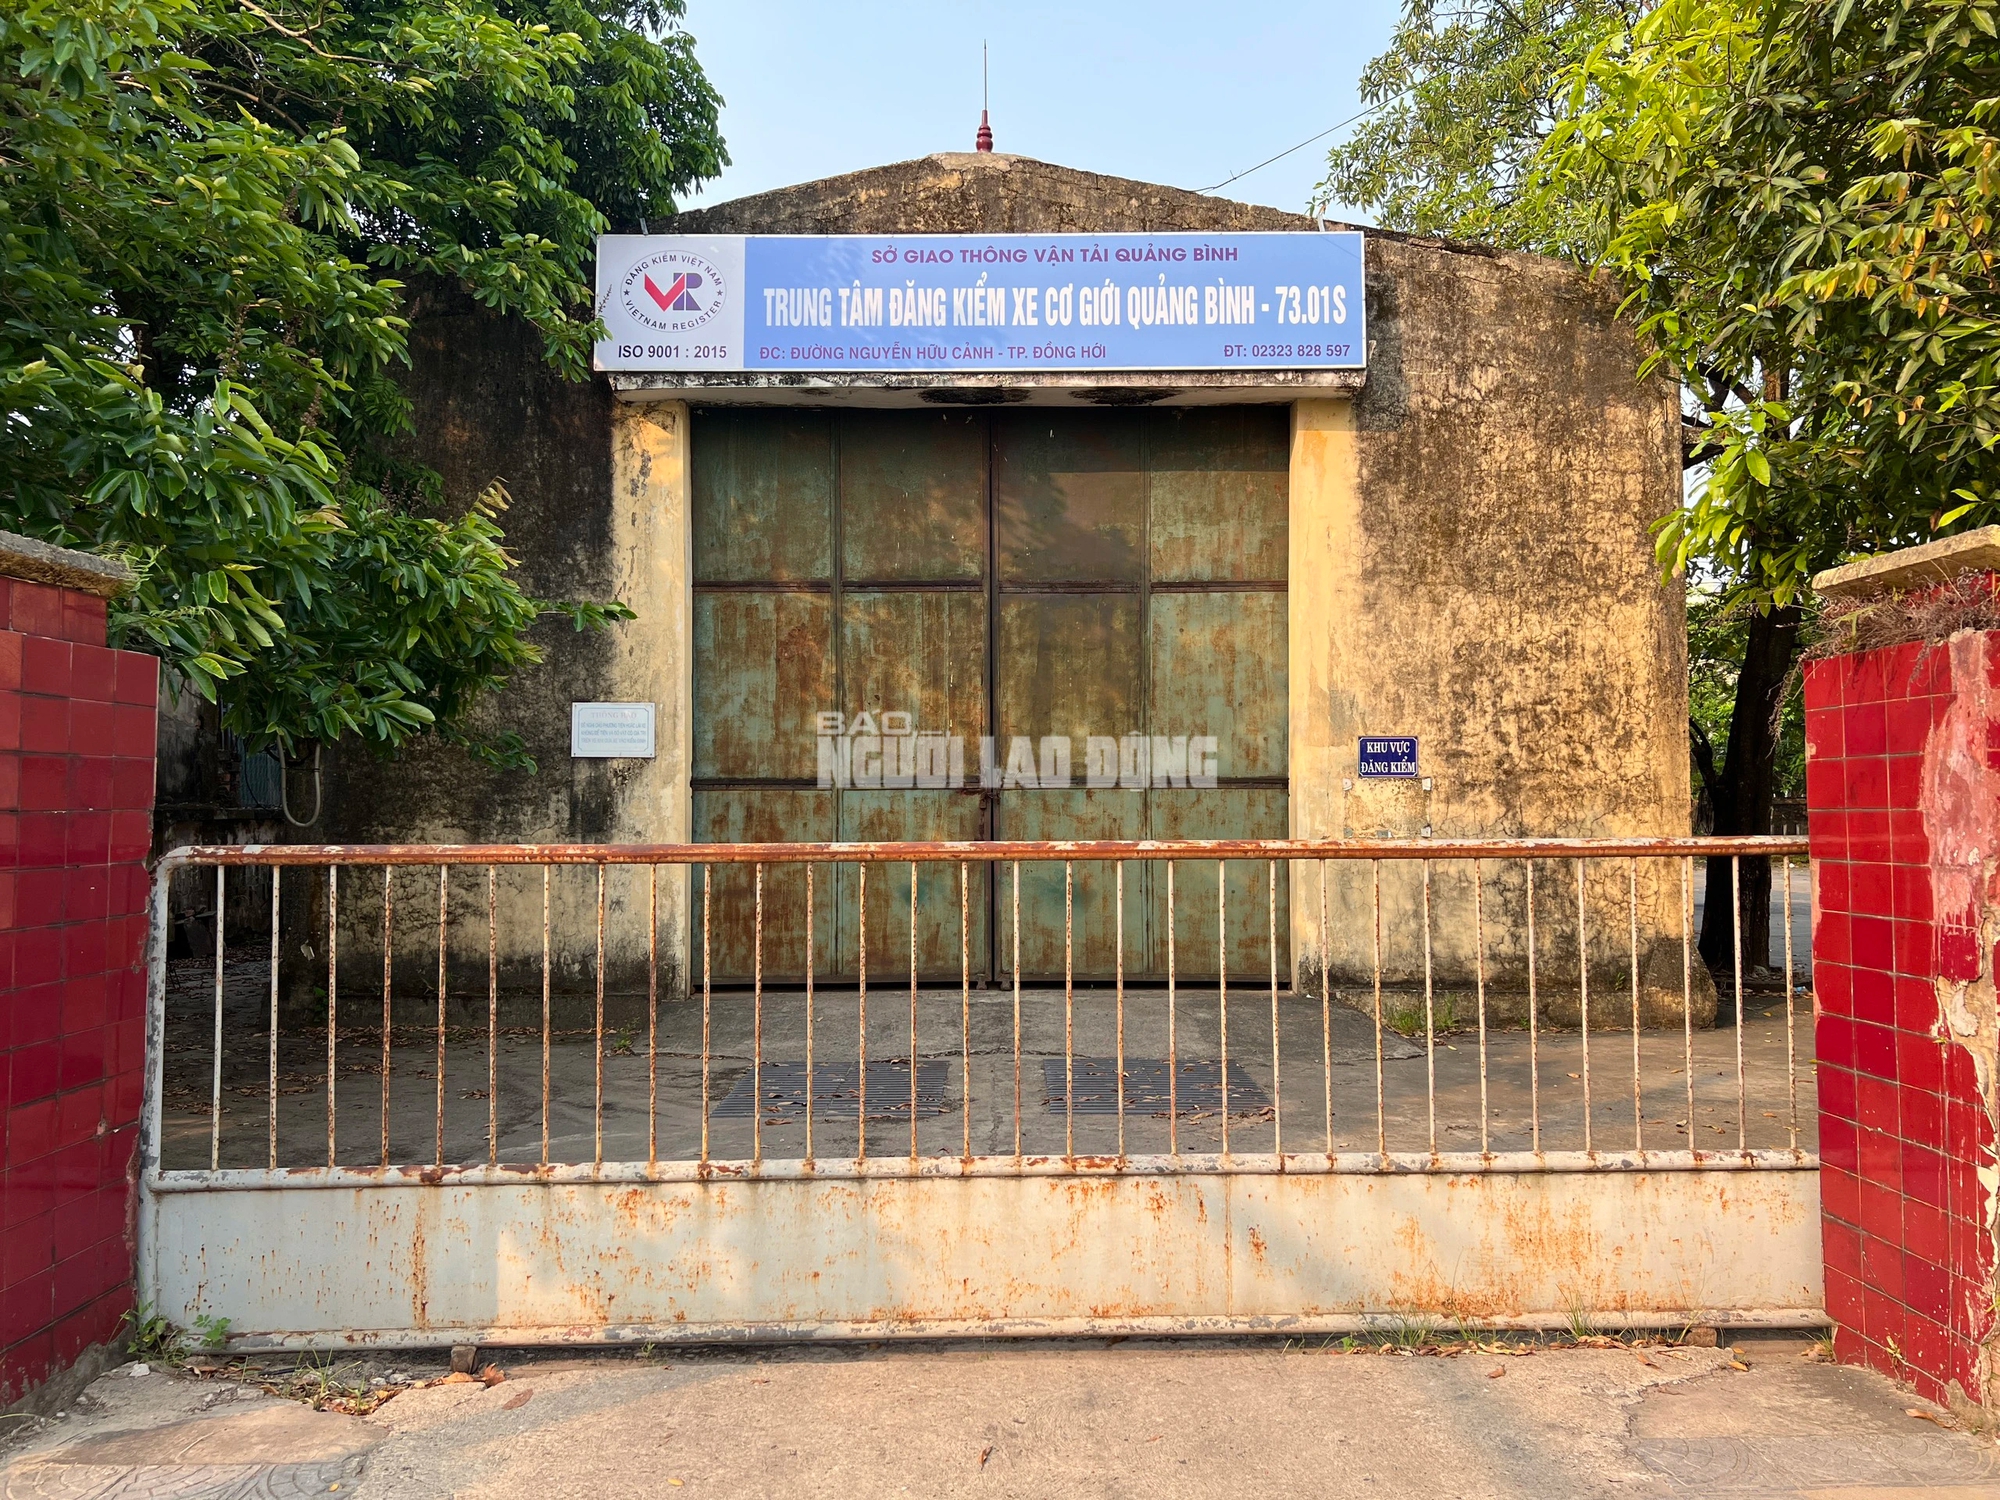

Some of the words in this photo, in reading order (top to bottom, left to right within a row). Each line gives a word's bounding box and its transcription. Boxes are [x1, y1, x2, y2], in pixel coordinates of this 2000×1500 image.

[871, 245, 898, 264] SỞ
[904, 249, 954, 264] GIAO
[960, 245, 1028, 263] THÔNG
[1034, 245, 1074, 266] VẬN
[1080, 243, 1109, 262] TẢI
[1115, 243, 1187, 262] QUẢNG
[1193, 243, 1238, 262] BÌNH
[704, 265, 723, 286] NAM
[763, 287, 832, 327] TRUNG
[838, 279, 883, 327] TÂM
[888, 279, 947, 327] ĐĂNG
[953, 271, 1006, 327] KIỂM
[1012, 287, 1039, 327] XE
[1045, 283, 1073, 326] CƠ
[1079, 278, 1121, 326] GIỚI
[1127, 272, 1198, 330] QUẢNG
[1204, 277, 1255, 325] BÌNH
[1261, 303, 1270, 312] -
[1275, 284, 1347, 325] 73.01S
[625, 299, 667, 330] VIETNAM
[672, 299, 722, 331] REGISTER
[618, 345, 644, 358] ISO
[647, 345, 680, 358] 9001
[694, 345, 727, 358] 2015
[759, 346, 786, 360] ĐC:
[790, 343, 844, 360] ĐƯỜNG
[849, 341, 912, 360] NGUYỄN
[917, 343, 947, 360] HỮU
[952, 342, 993, 359] CẢNH
[1007, 346, 1028, 359] TP.
[1033, 341, 1076, 359] ĐỒNG
[1081, 342, 1107, 359] HỚI
[1224, 345, 1247, 357] ĐT:
[1252, 344, 1293, 357] 02323
[1297, 344, 1322, 357] 828
[1326, 344, 1351, 357] 597
[1366, 742, 1388, 753] KHU
[1389, 740, 1410, 756] VỰC
[1361, 759, 1388, 773] ĐĂNG
[1390, 755, 1416, 773] KIỂM
